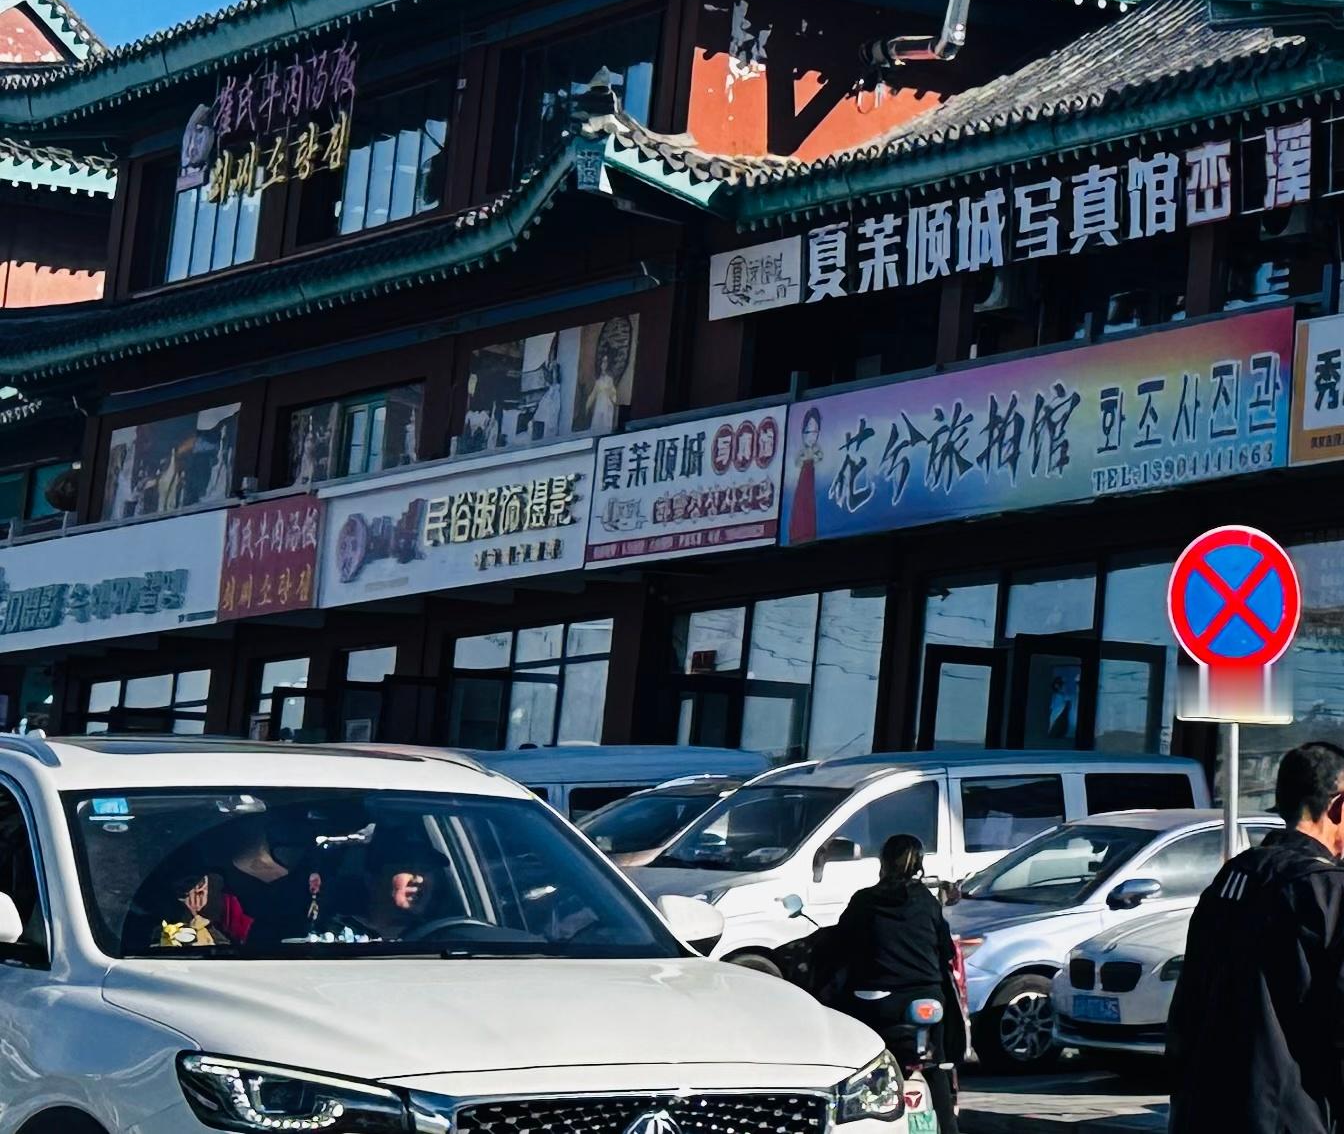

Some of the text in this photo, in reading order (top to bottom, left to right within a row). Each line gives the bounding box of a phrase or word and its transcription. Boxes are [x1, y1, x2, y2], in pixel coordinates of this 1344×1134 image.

[830, 382, 1082, 513] 花兮旅拍馆
[1096, 352, 1281, 454] 화조사진관
